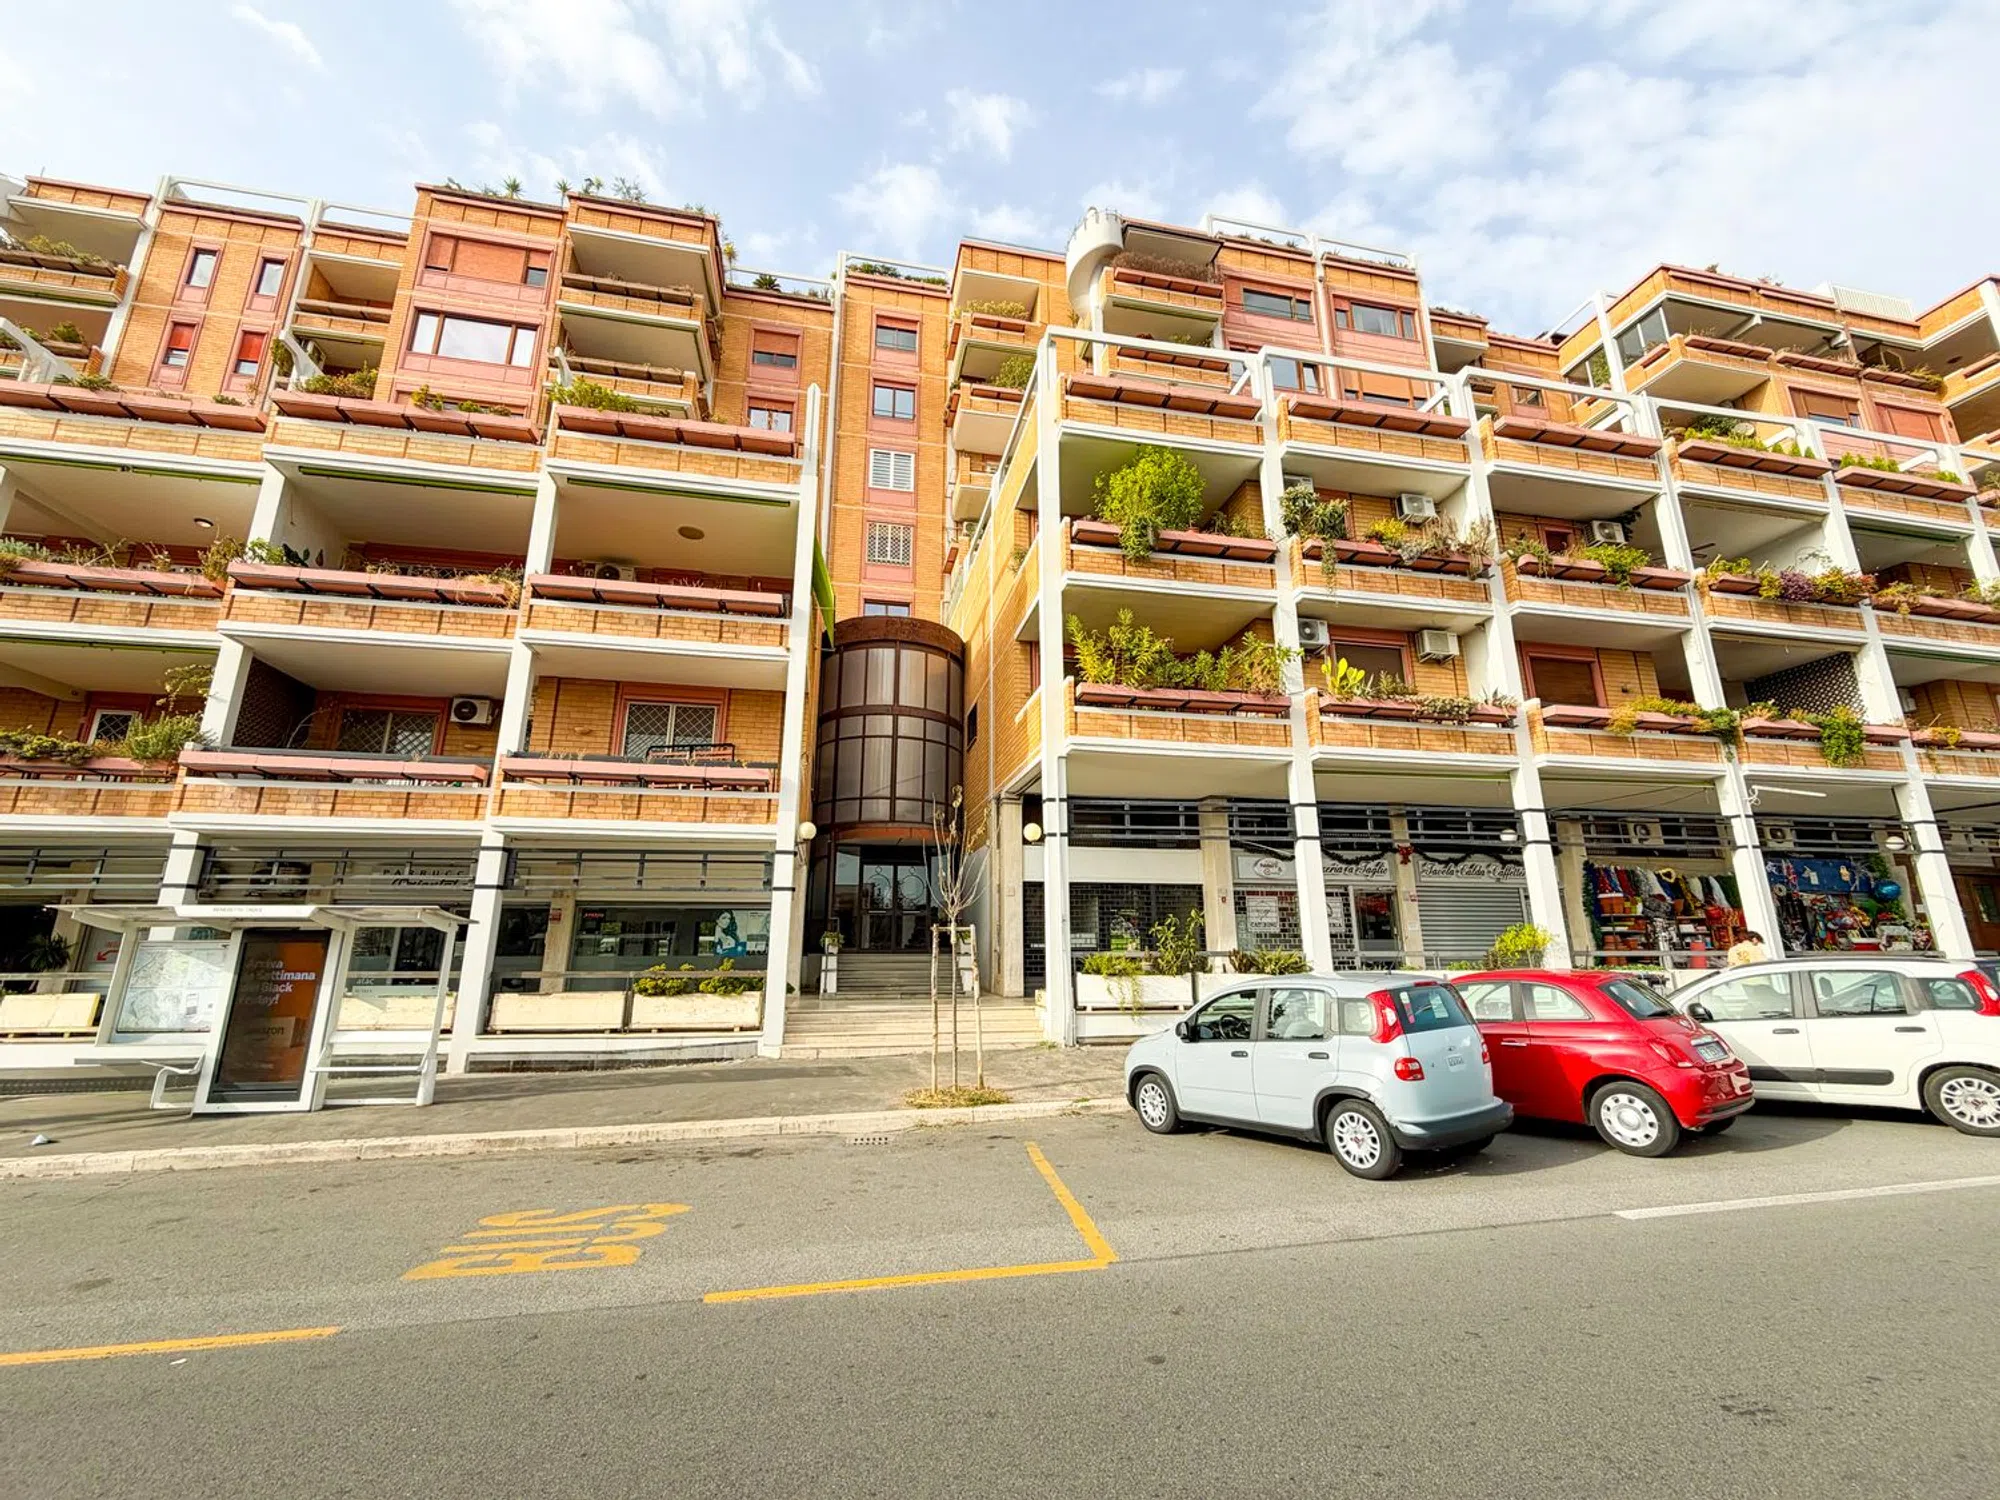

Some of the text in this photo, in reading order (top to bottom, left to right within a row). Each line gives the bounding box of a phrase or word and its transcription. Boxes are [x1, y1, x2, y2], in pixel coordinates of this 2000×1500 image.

[1355, 861, 1388, 878] Taglio
[1459, 862, 1486, 876] Calda
[261, 981, 294, 993] Black
[400, 1202, 694, 1280] BUS
